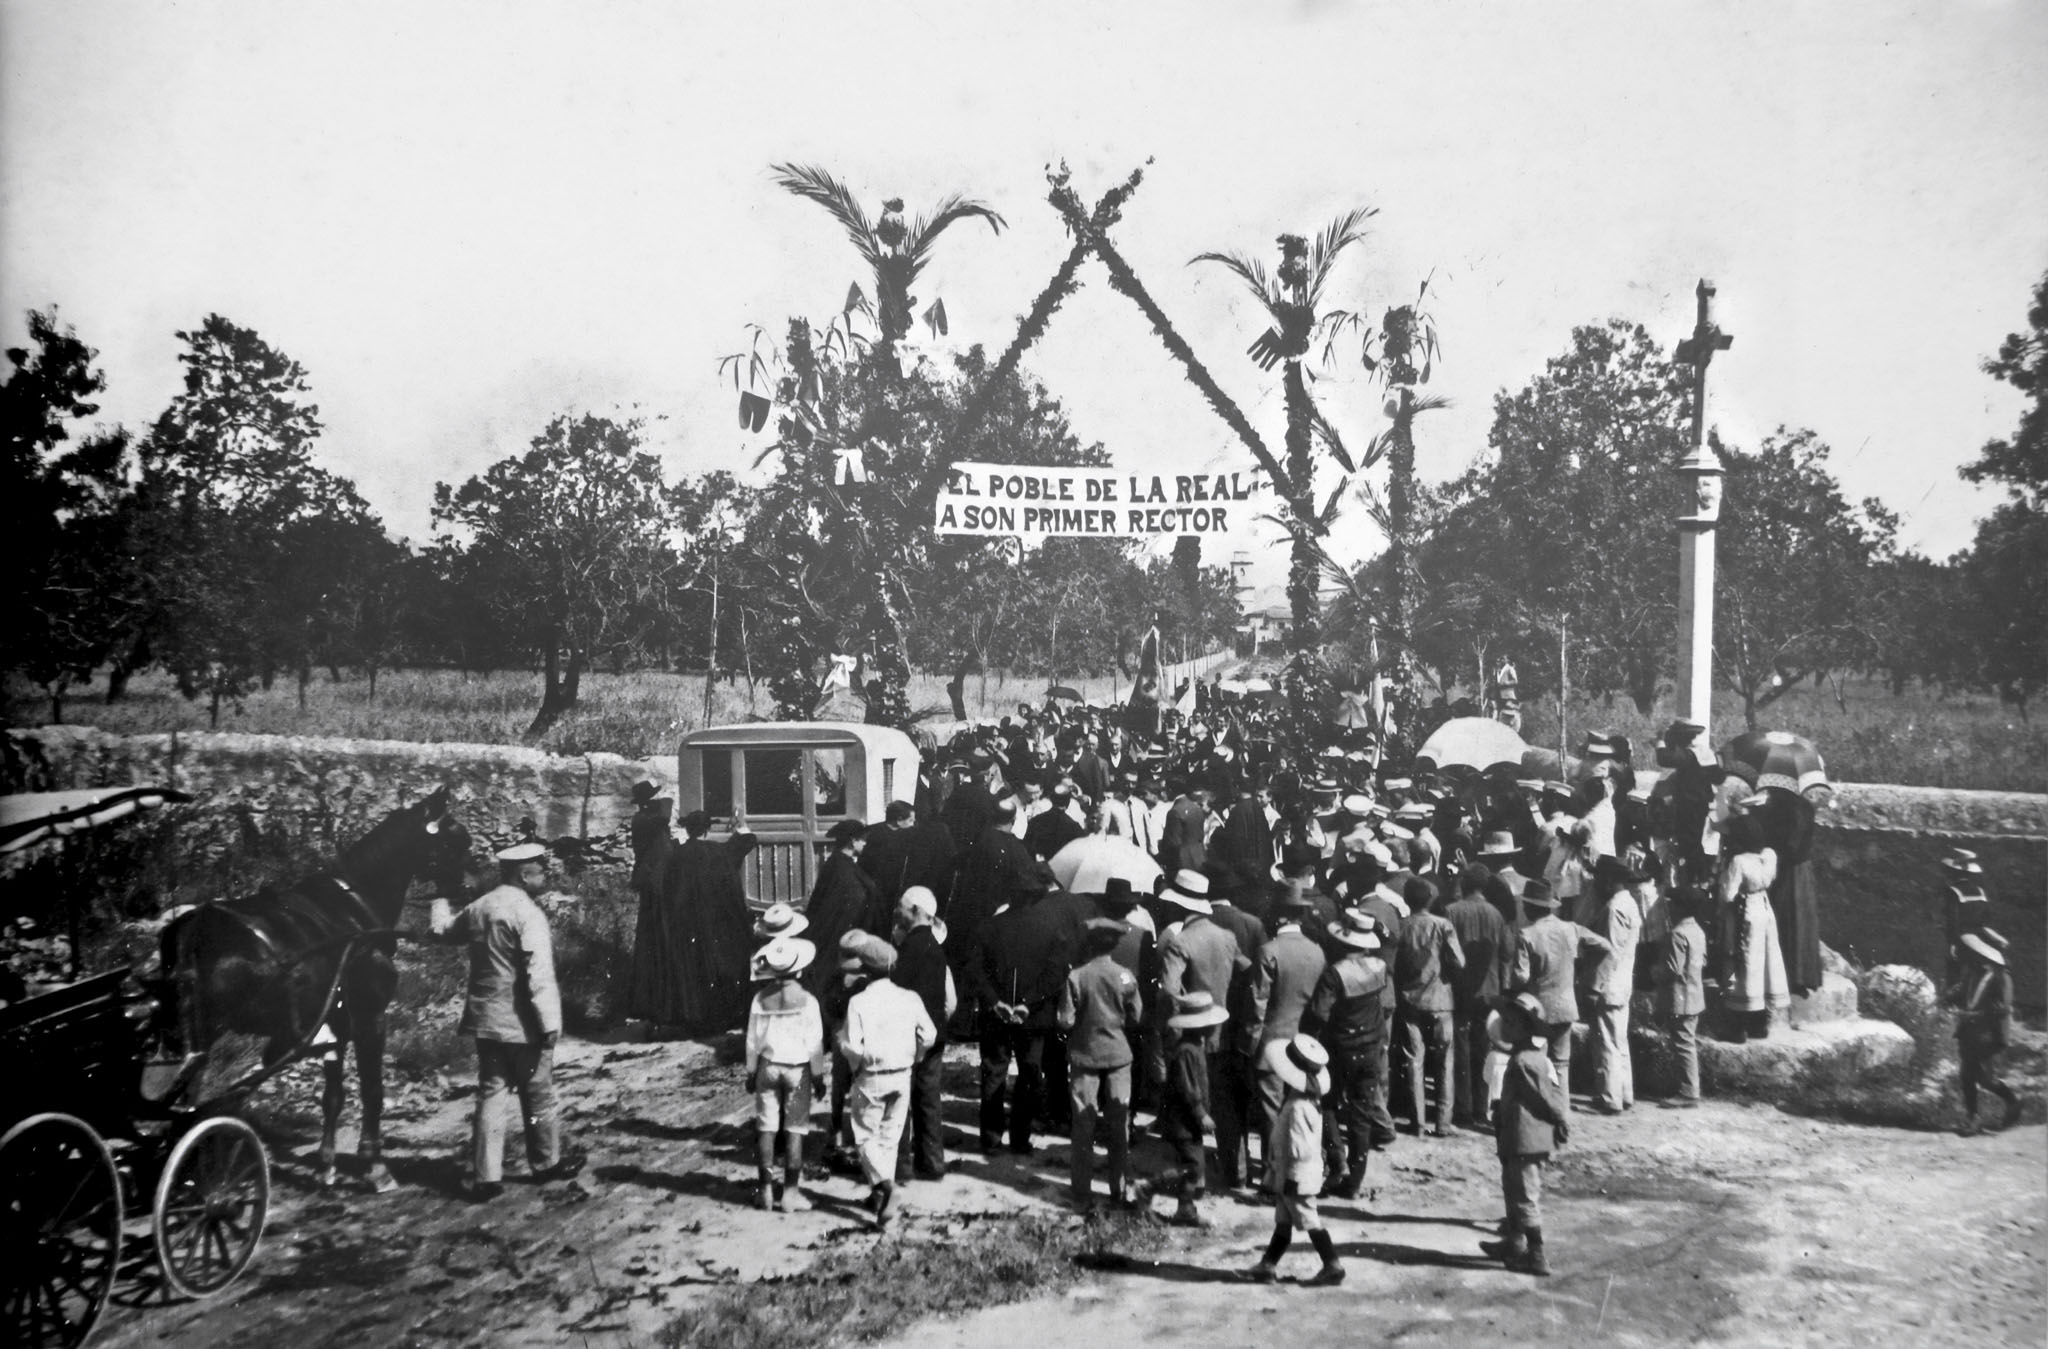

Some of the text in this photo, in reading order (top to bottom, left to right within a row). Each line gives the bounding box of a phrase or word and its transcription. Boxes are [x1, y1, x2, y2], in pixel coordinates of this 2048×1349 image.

[989, 475, 1074, 501] POBLE
[1086, 479, 1118, 502] DE
[1129, 476, 1167, 503] LA
[1176, 473, 1249, 503] REAL
[939, 504, 1228, 534] A SON PRIMER RECTOR
